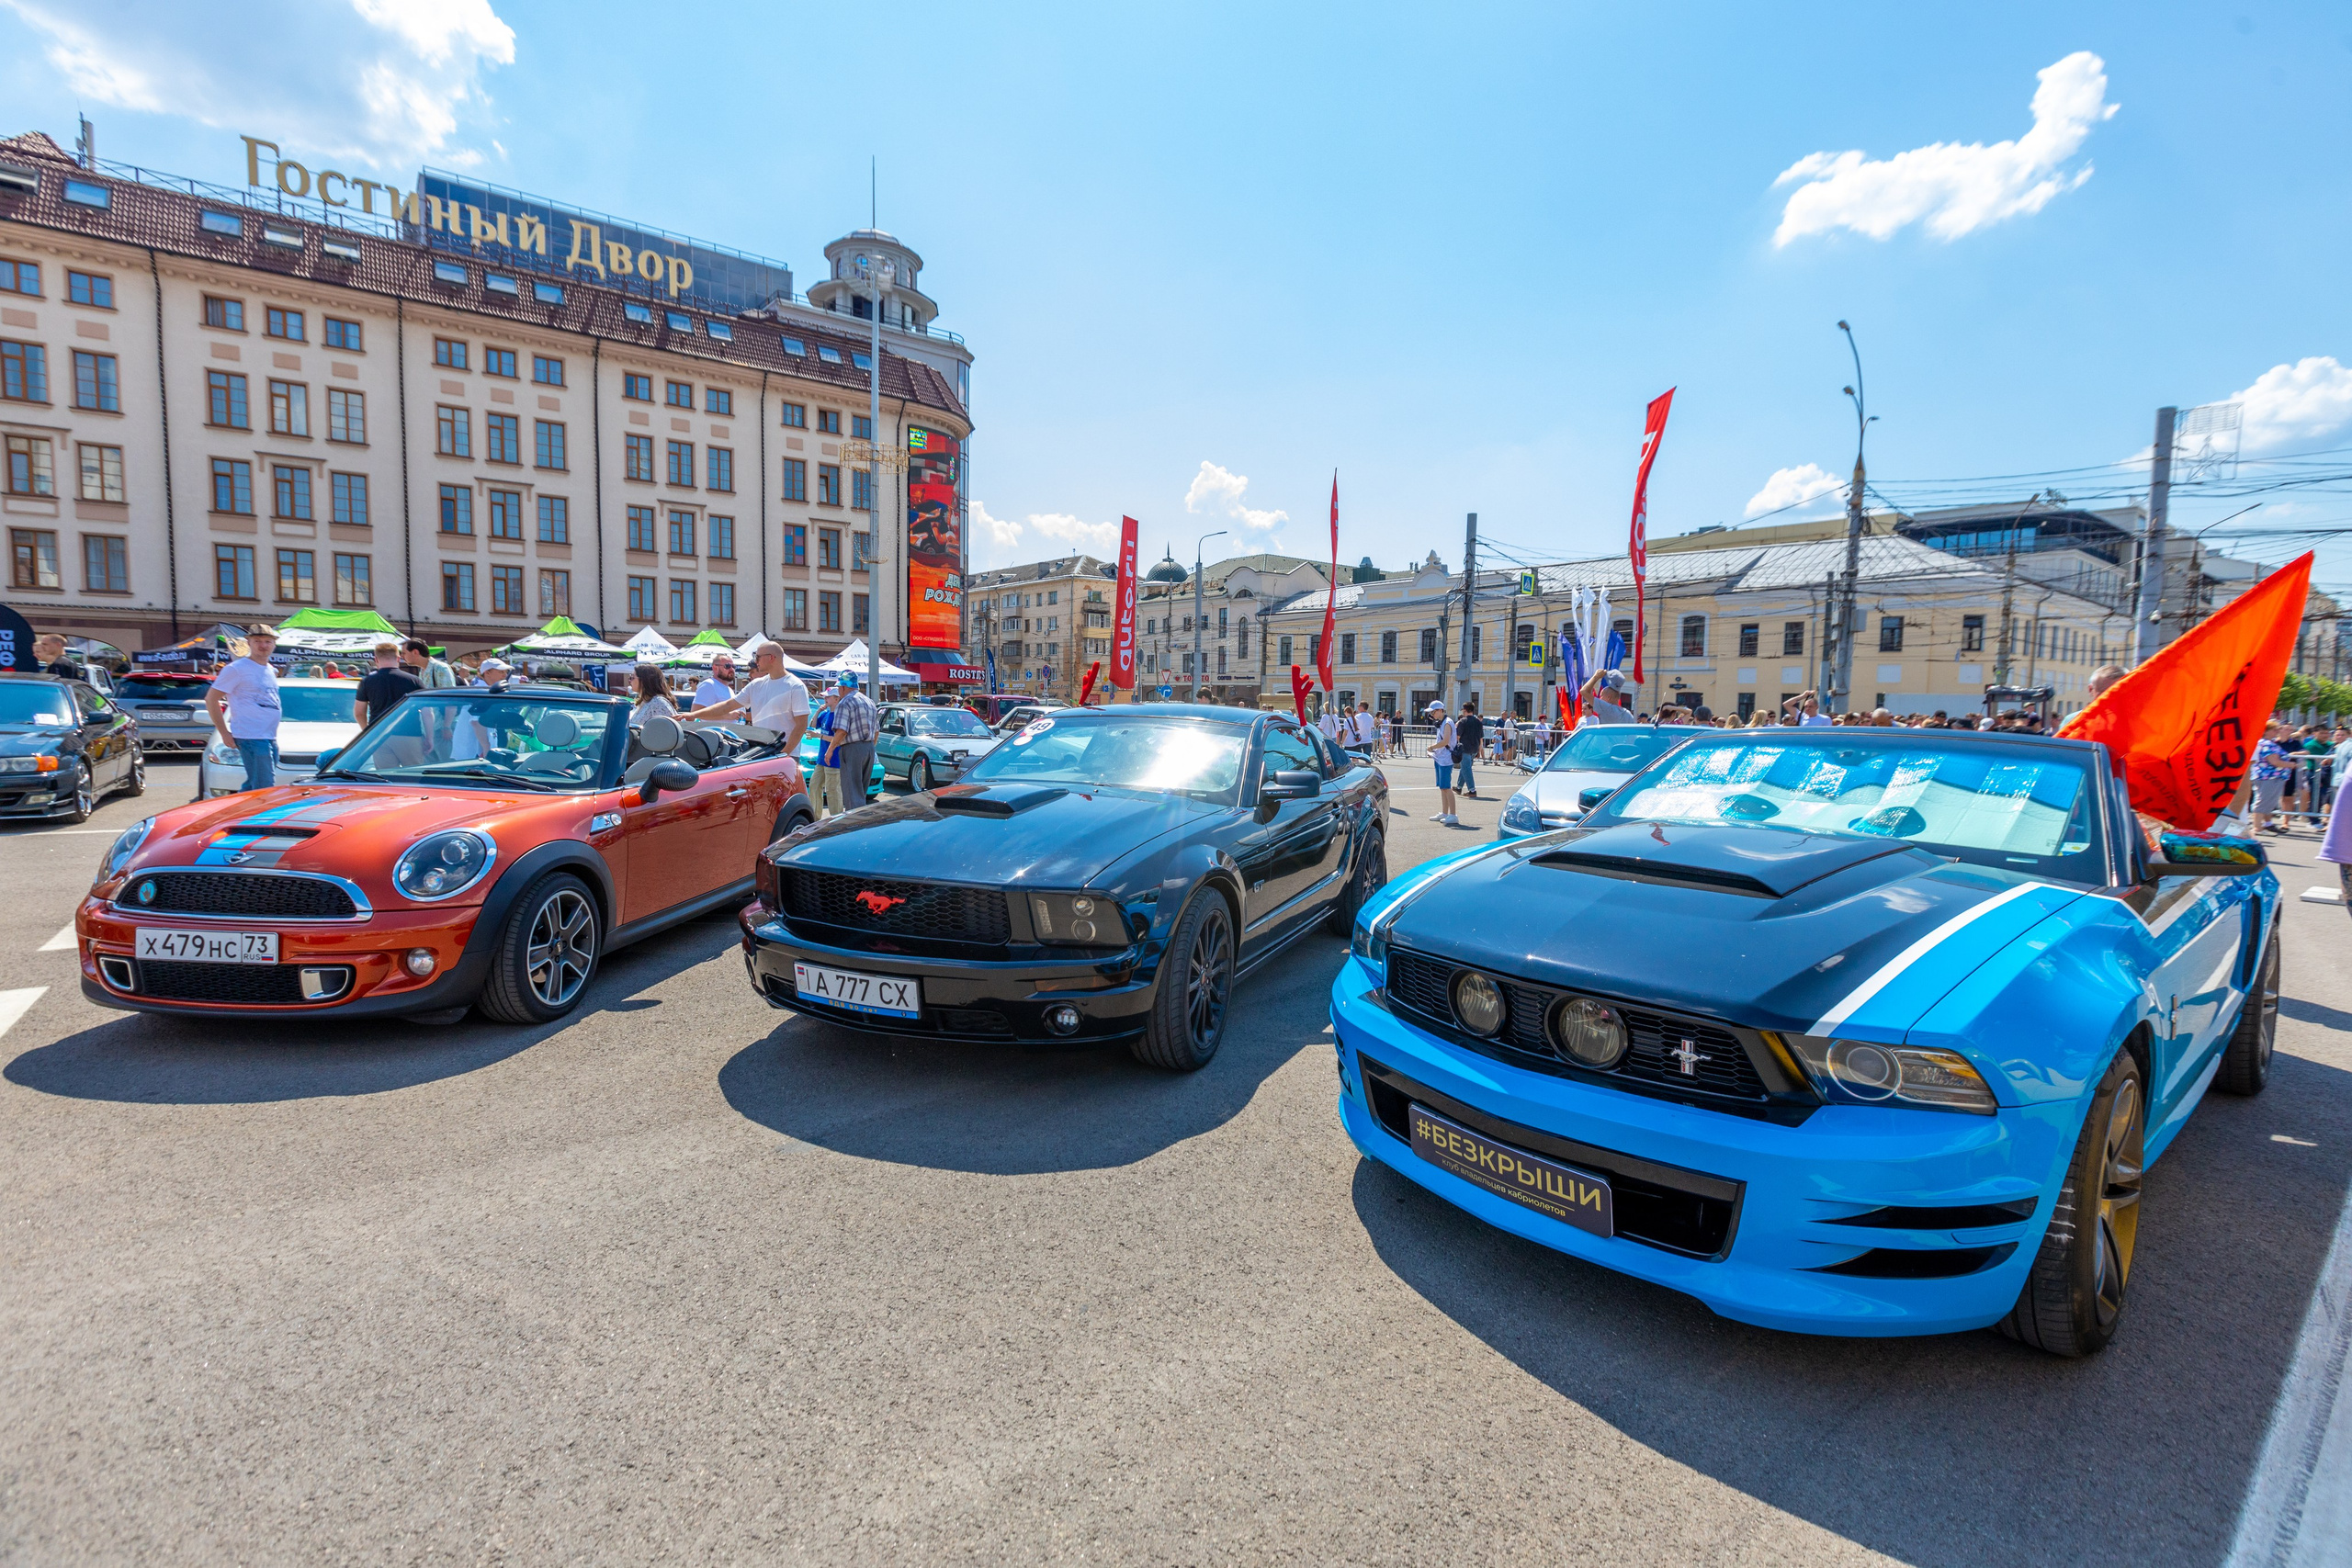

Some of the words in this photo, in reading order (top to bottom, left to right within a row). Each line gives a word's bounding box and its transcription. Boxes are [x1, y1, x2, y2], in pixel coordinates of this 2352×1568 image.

[240, 134, 546, 255] Гостиный
[566, 219, 695, 298] Двор
[1120, 540, 1136, 671] auto.ru
[288, 648, 345, 658] ALPHARD
[347, 651, 376, 660] GROU
[1030, 722, 1051, 730] 49
[145, 933, 237, 958] Х479НС
[244, 936, 267, 953] 73
[835, 975, 870, 1001] 777
[1416, 1118, 1601, 1212] #БЕЗКРЫШИ
[1442, 1158, 1460, 1171] клуб
[1460, 1167, 1506, 1193] владельцев
[1508, 1189, 1566, 1217] кабриолетов
